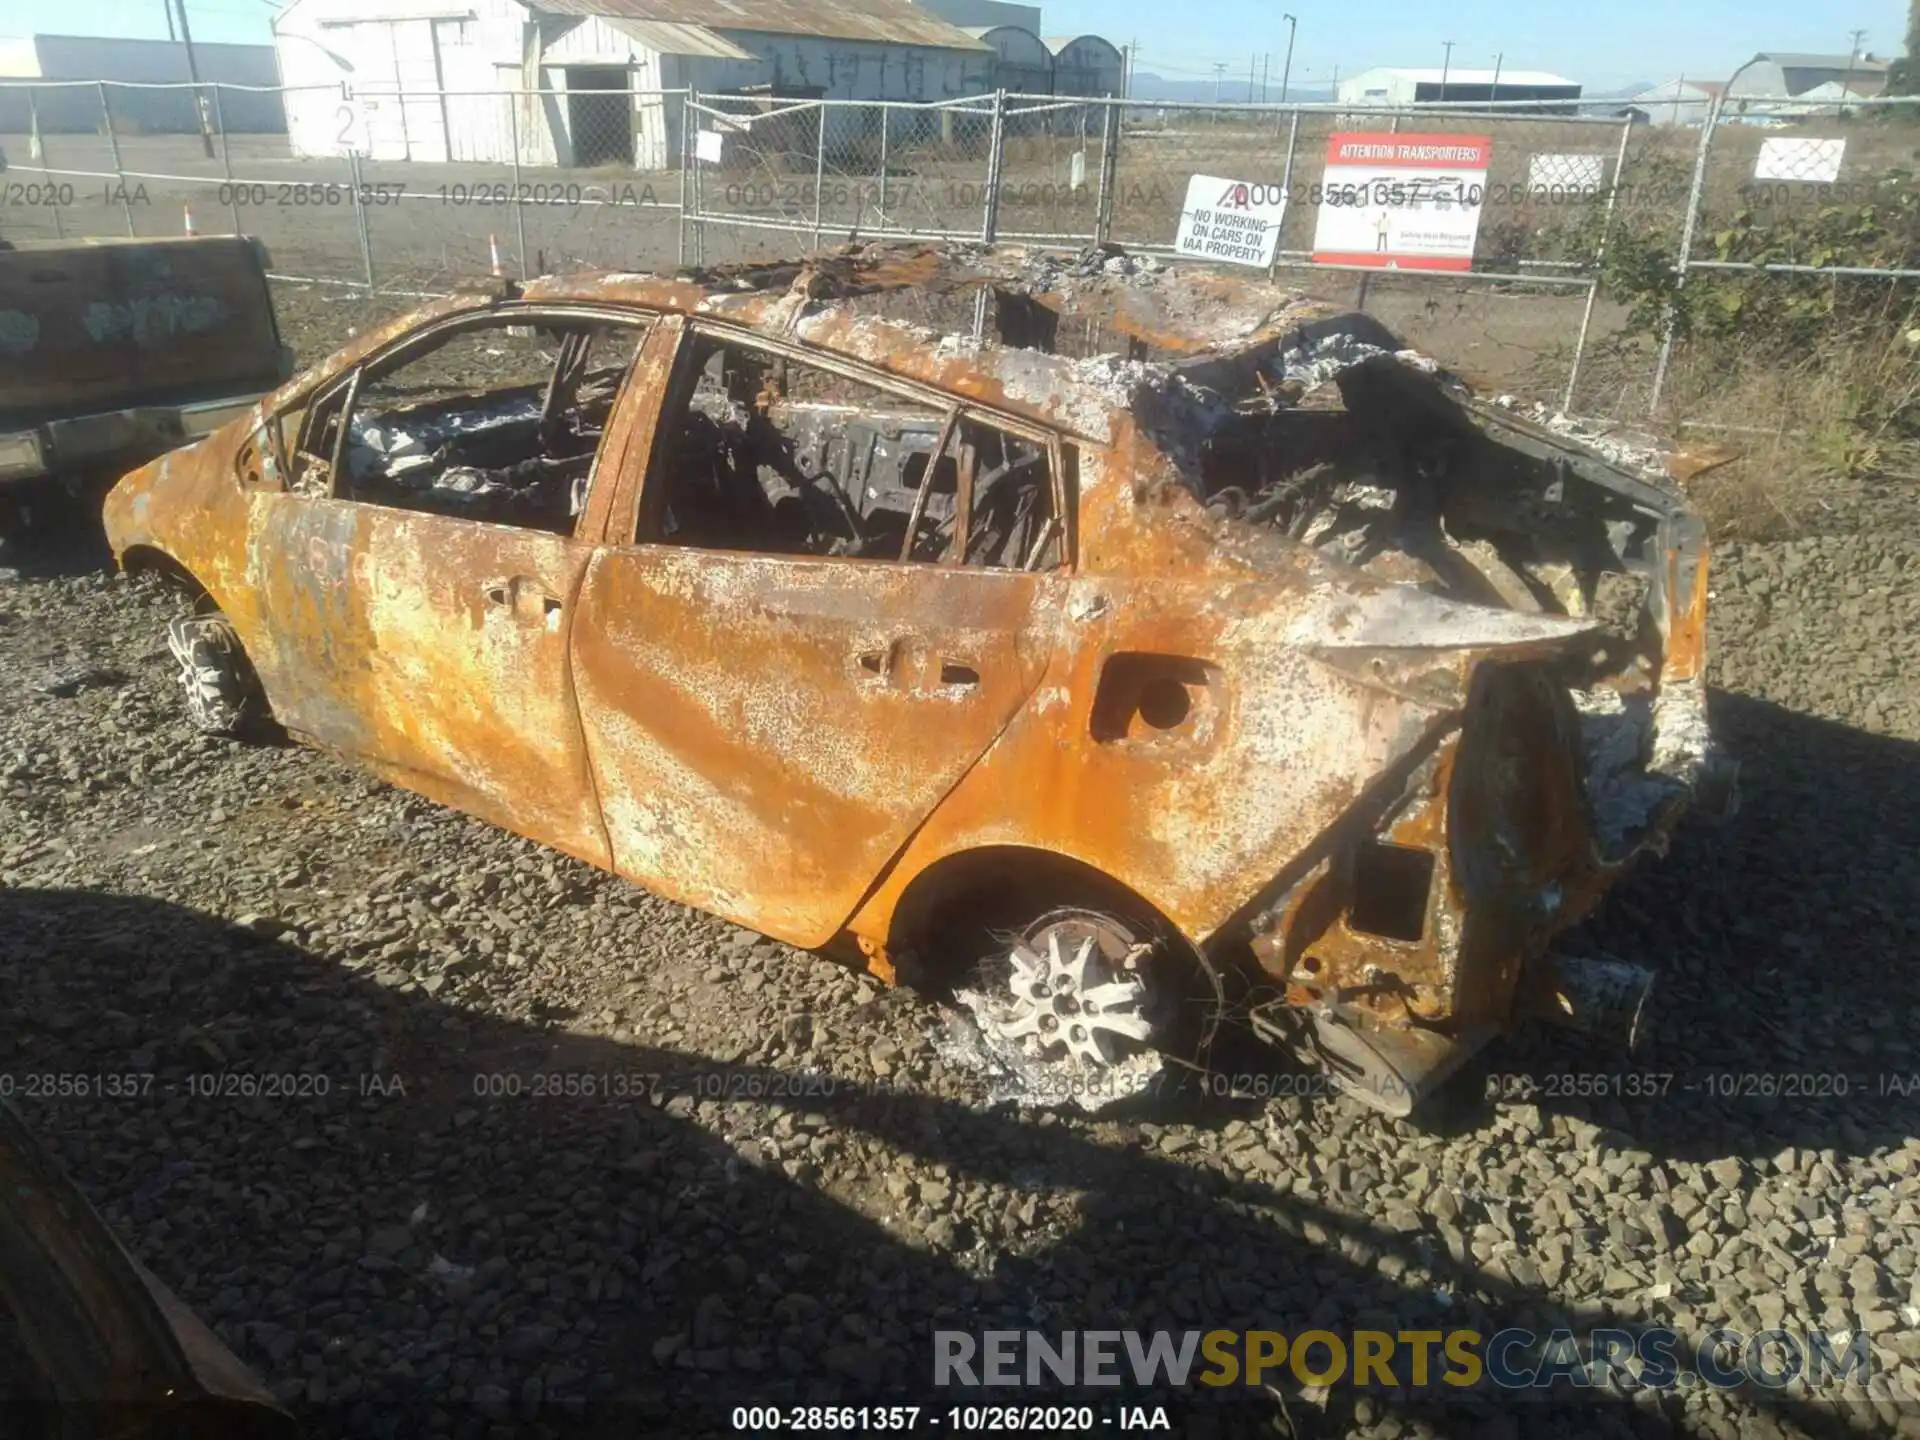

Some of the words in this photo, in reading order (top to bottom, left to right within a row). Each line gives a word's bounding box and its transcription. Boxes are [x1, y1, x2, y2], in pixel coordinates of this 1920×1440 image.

[335, 105, 355, 146] 2
[1339, 143, 1394, 160] ATTENTION
[1397, 144, 1481, 162] TRANSPORTERS!
[1194, 208, 1211, 223] NO
[1214, 211, 1268, 233] WORKING
[1192, 223, 1209, 238] ON
[1211, 226, 1244, 244] CARS
[1245, 233, 1263, 247] ON
[1183, 236, 1202, 251] IAA
[1205, 241, 1267, 263] PROPERTY
